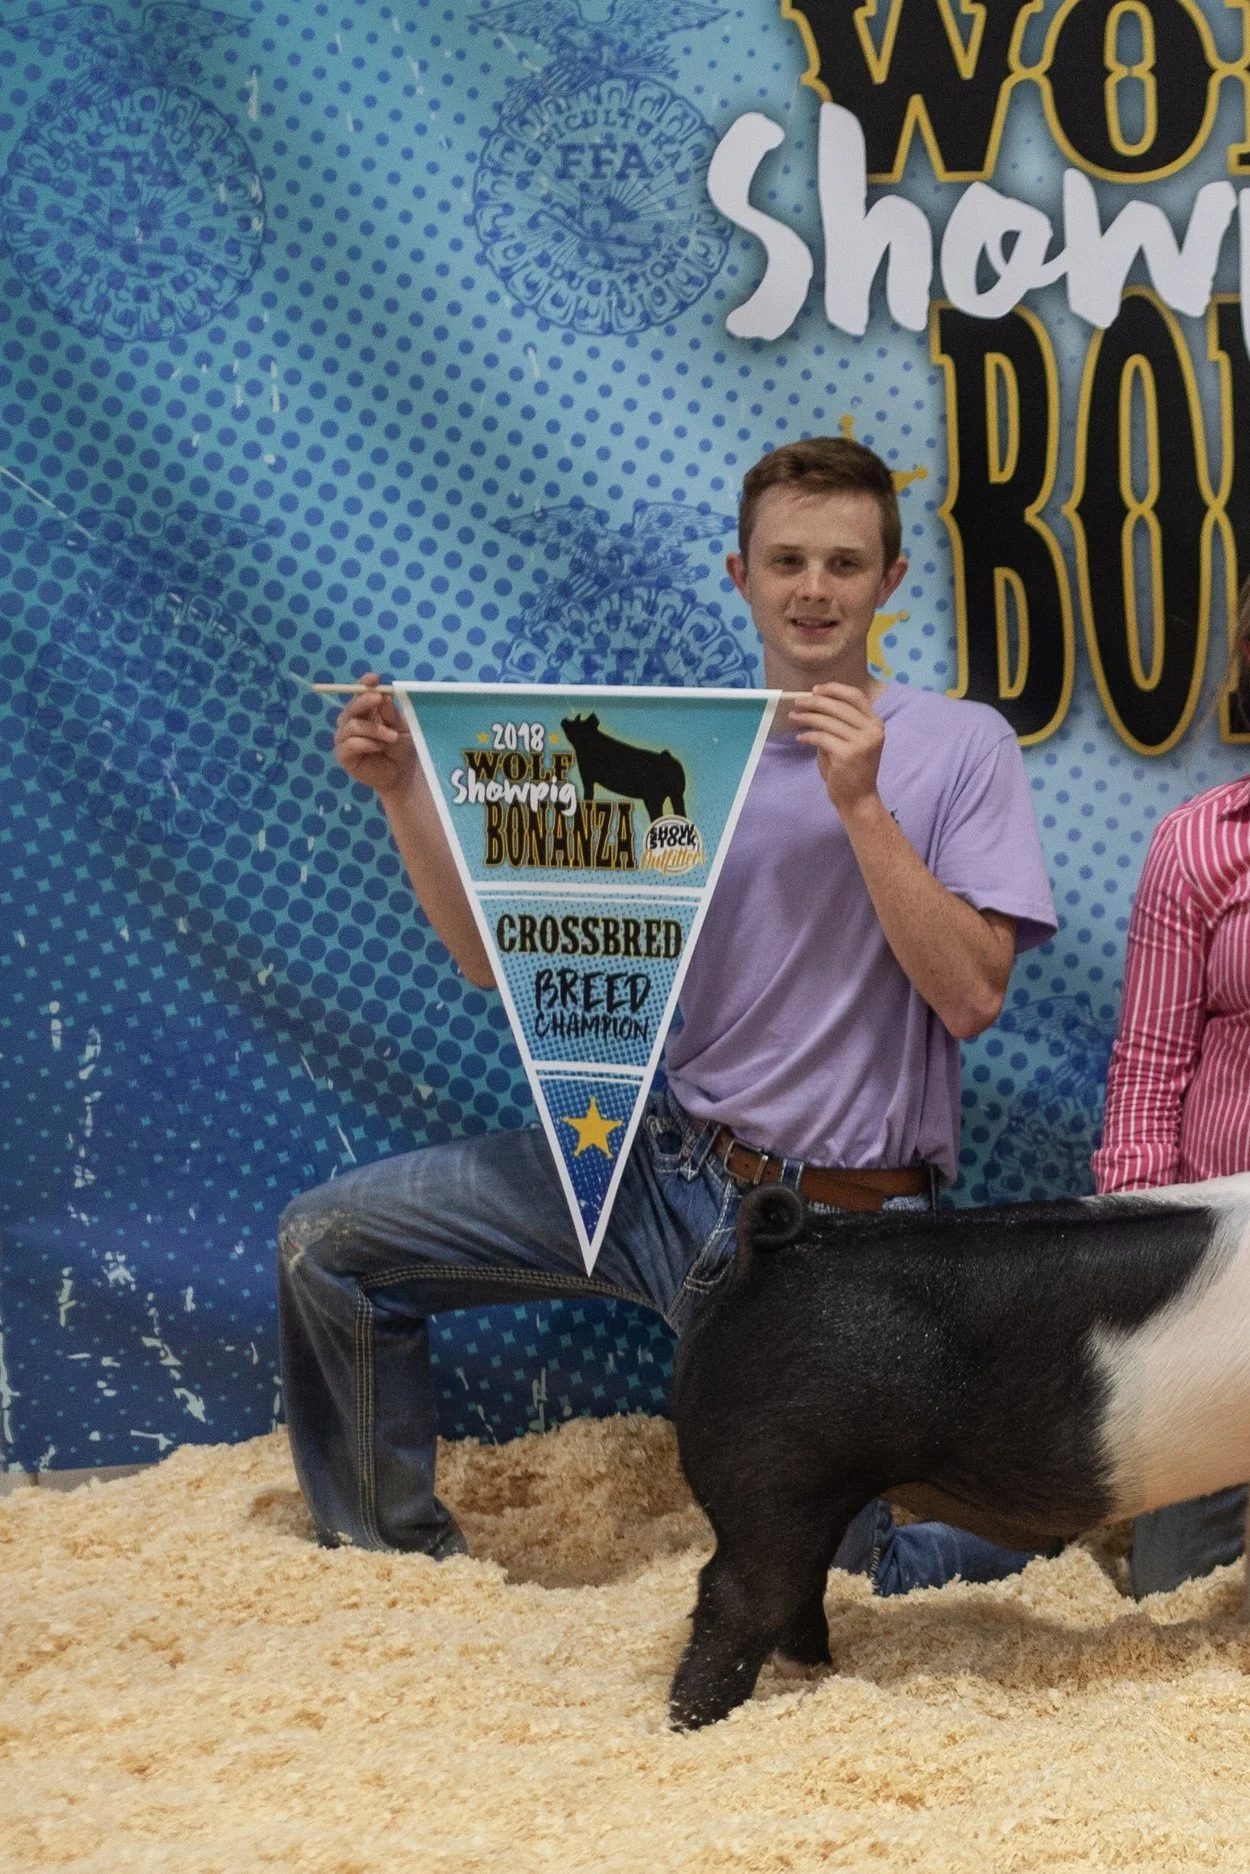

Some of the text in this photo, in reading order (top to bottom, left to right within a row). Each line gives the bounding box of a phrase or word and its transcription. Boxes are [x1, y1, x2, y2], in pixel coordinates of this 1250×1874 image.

[557, 141, 655, 181] FFA
[492, 721, 545, 752] 2018
[463, 749, 575, 782] WOLF
[451, 768, 577, 816] Showpig
[484, 799, 636, 871] BONANZA
[649, 823, 695, 839] SHOW
[649, 833, 697, 850] STOCK
[497, 913, 684, 960] CROSSBRED
[534, 967, 652, 1015] BREED
[534, 1012, 649, 1042] CHAMPION
